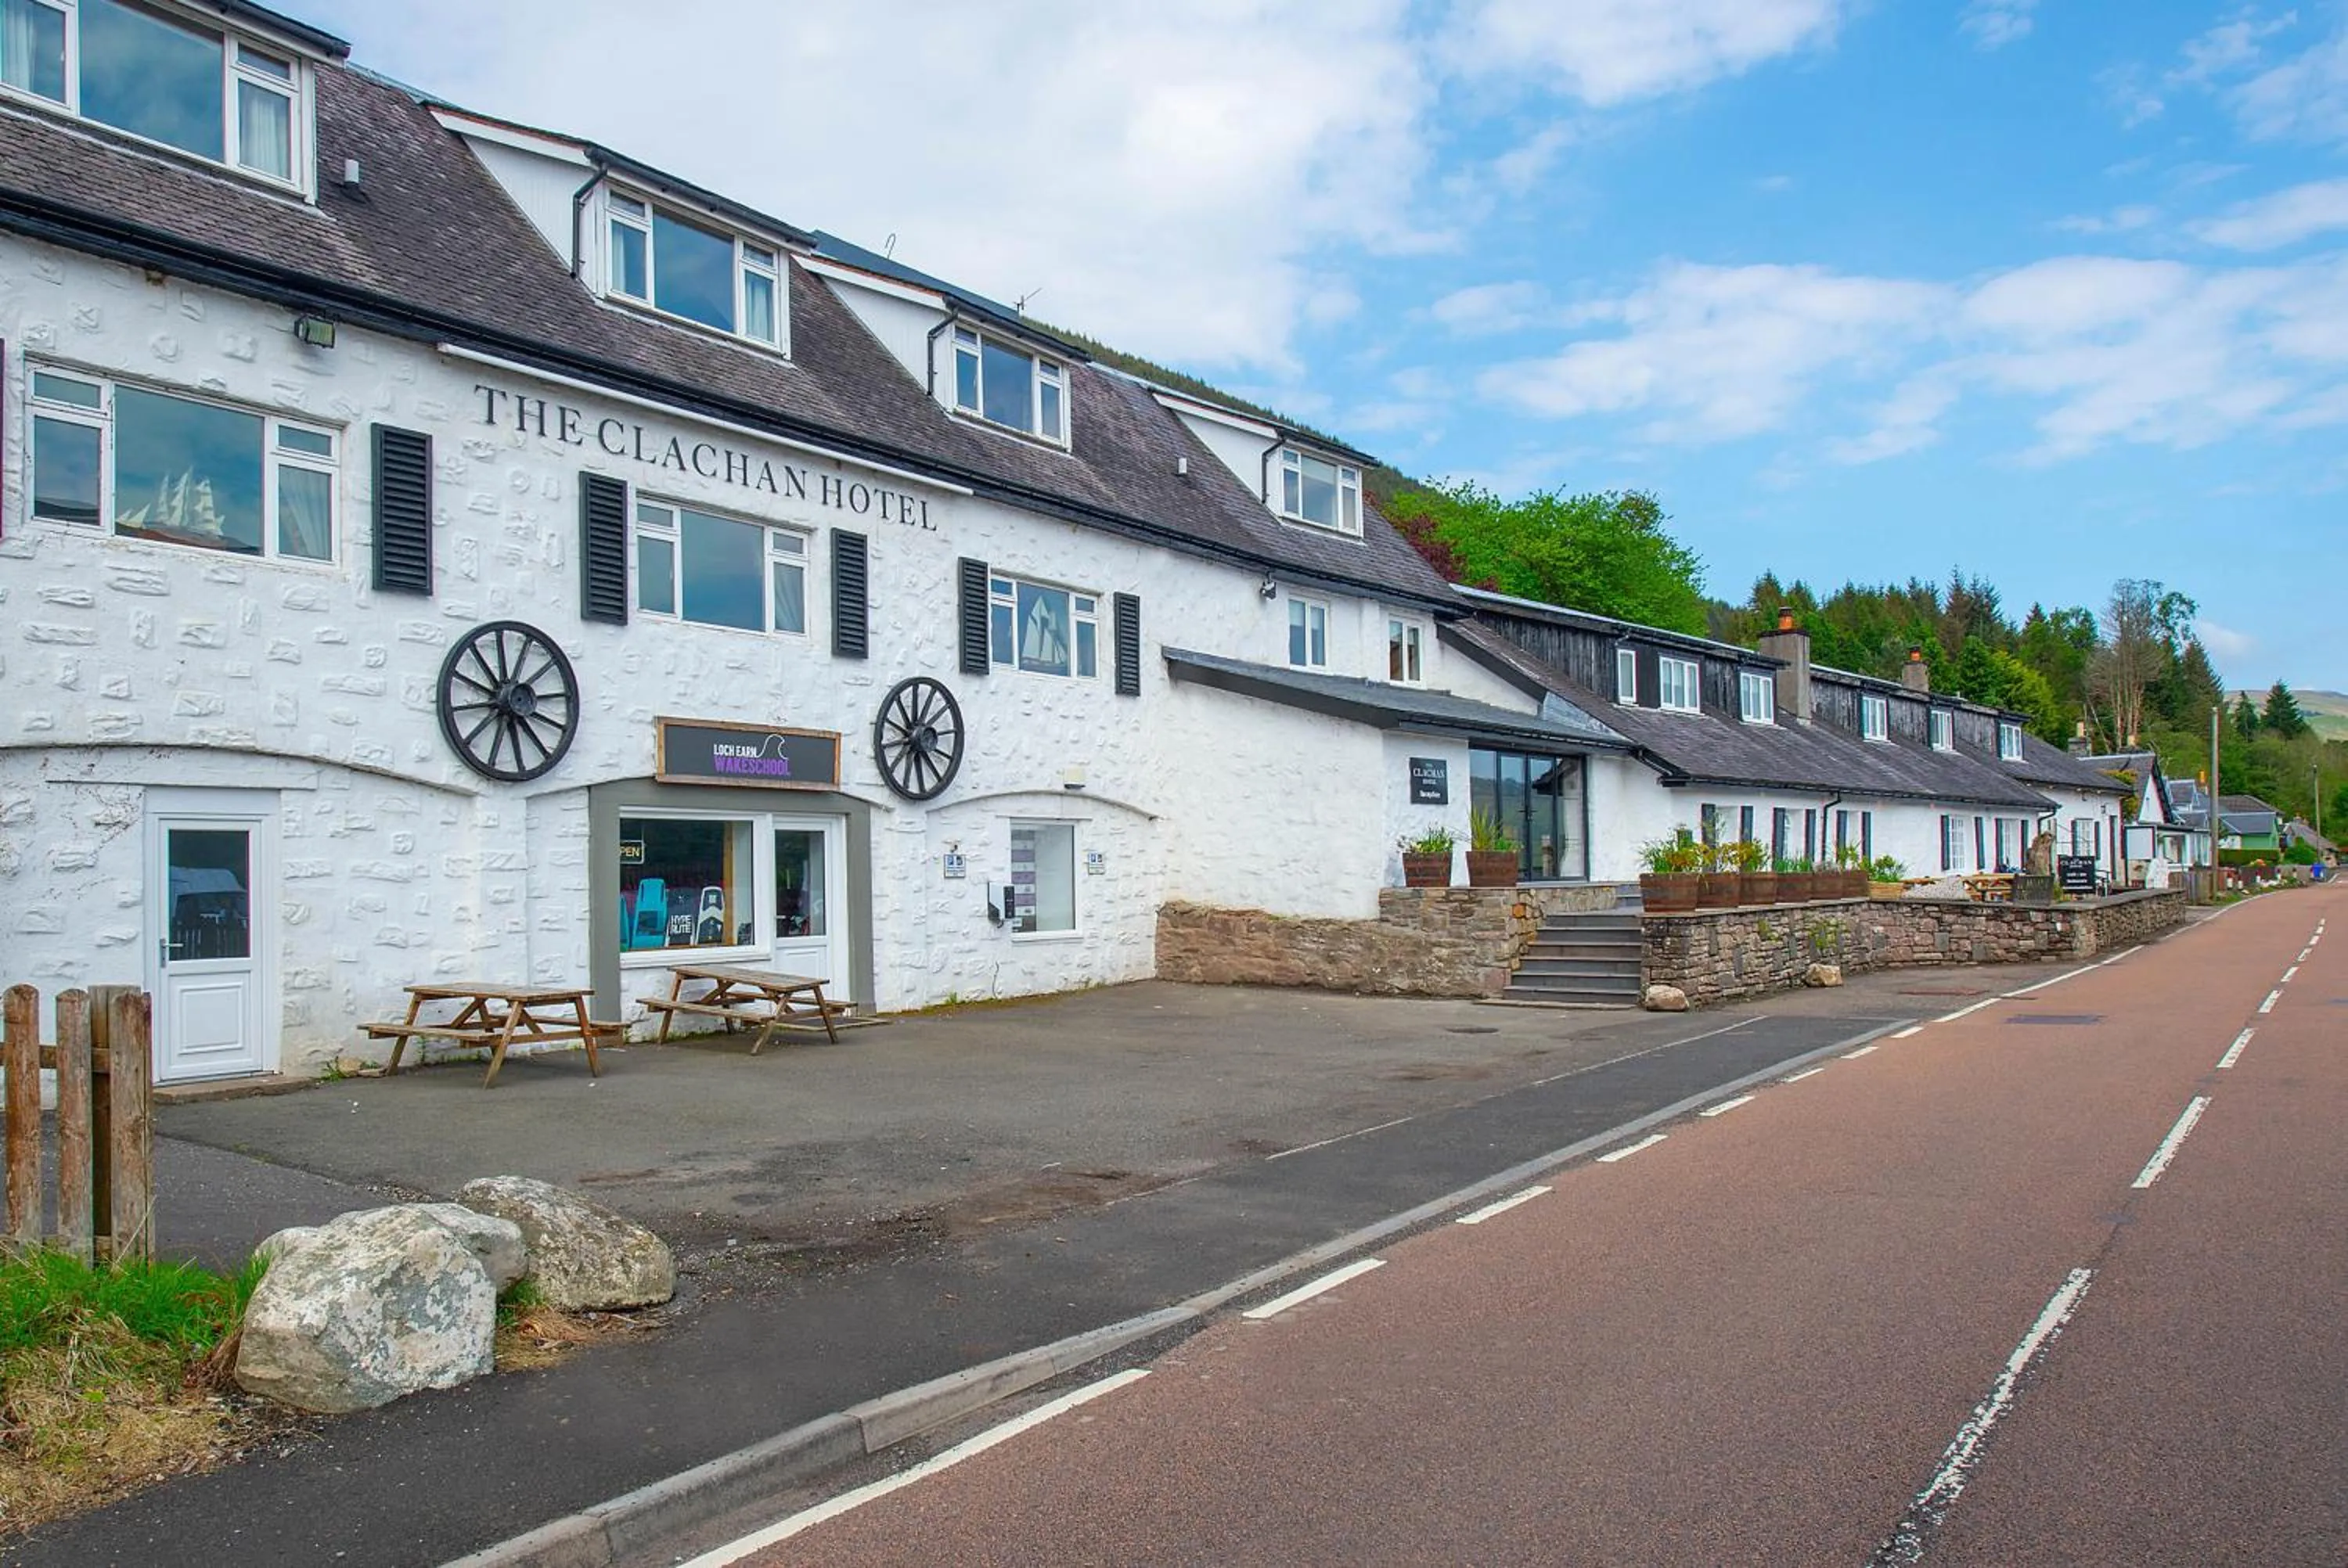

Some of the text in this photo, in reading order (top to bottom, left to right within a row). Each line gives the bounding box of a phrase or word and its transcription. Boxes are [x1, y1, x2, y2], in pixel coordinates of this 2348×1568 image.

[474, 384, 938, 531] THE CLACHAN HOTEL
[713, 743, 758, 757] LOCH EARN
[714, 756, 790, 775] WAKESCHOOL
[619, 846, 640, 857] PEN
